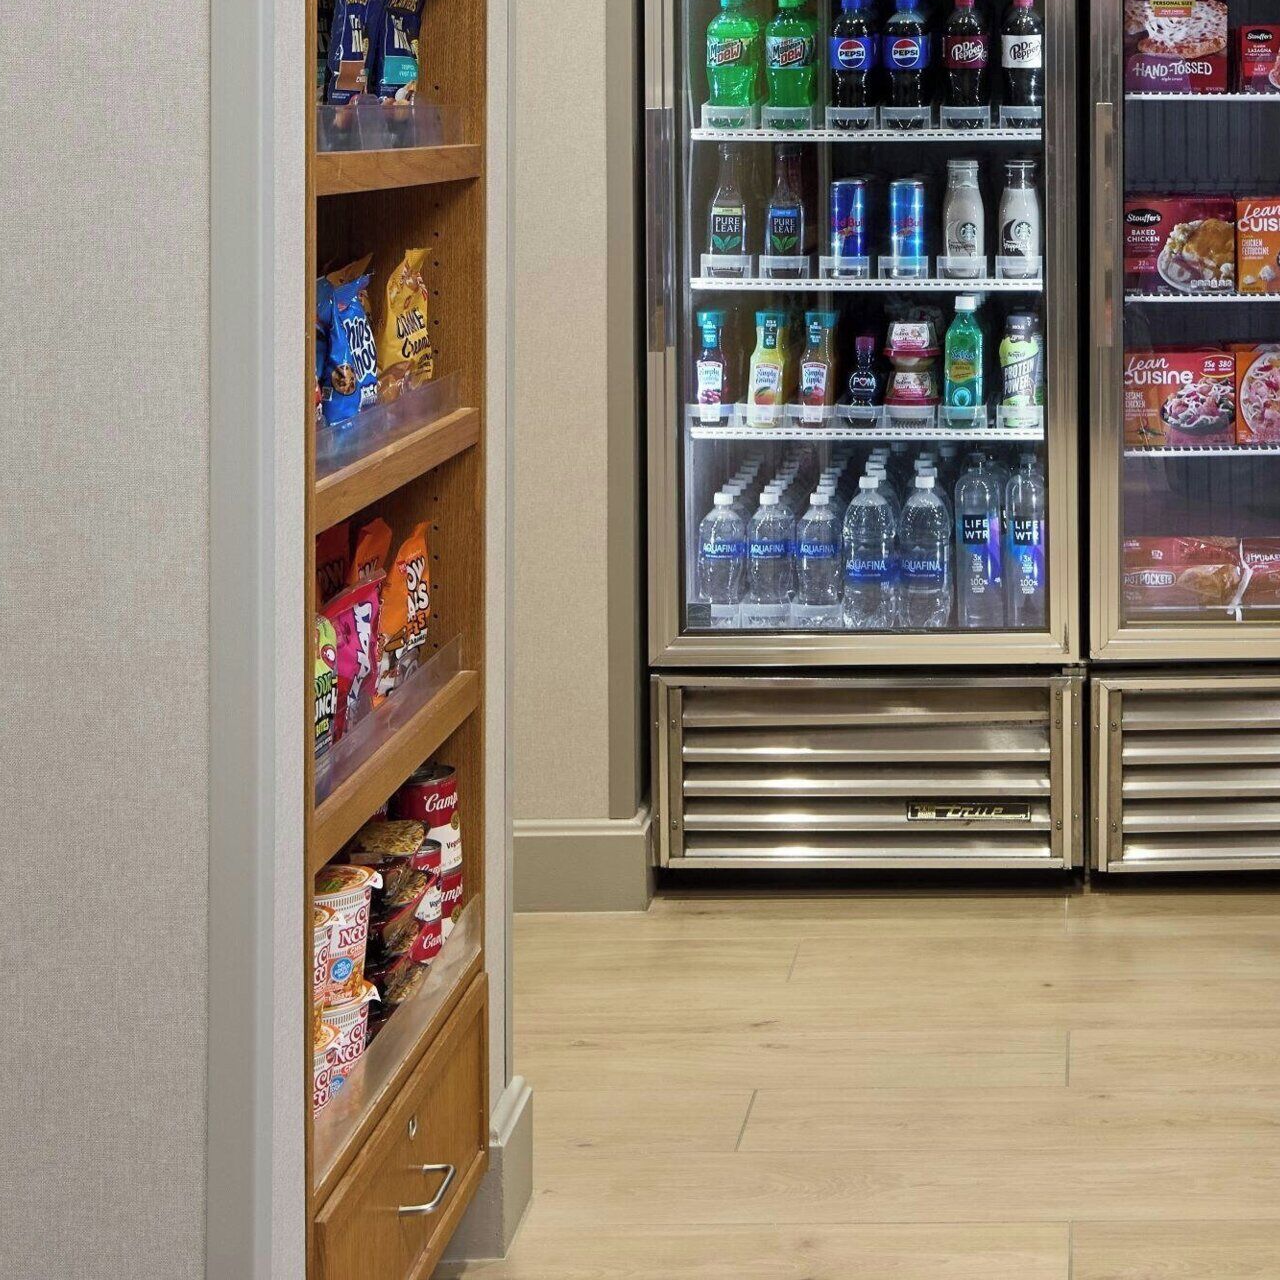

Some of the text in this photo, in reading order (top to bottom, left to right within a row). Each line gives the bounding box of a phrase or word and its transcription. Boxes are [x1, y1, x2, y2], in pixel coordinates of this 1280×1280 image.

[839, 50, 865, 58] PEPSI
[715, 216, 740, 224] PURE
[774, 218, 795, 226] PURE
[1126, 214, 1161, 223] Stouffer's
[715, 225, 740, 233] LEAF
[1127, 357, 1169, 372] Lean
[965, 519, 988, 528] LIFE
[1015, 521, 1039, 530] LIFE
[965, 530, 989, 539] WTR
[1015, 531, 1039, 541] WTR
[703, 543, 737, 554] AQUAFINA
[750, 543, 784, 555] AQUAFINA
[800, 544, 834, 555] AQUAFINA
[846, 559, 886, 572] AQUAFINA
